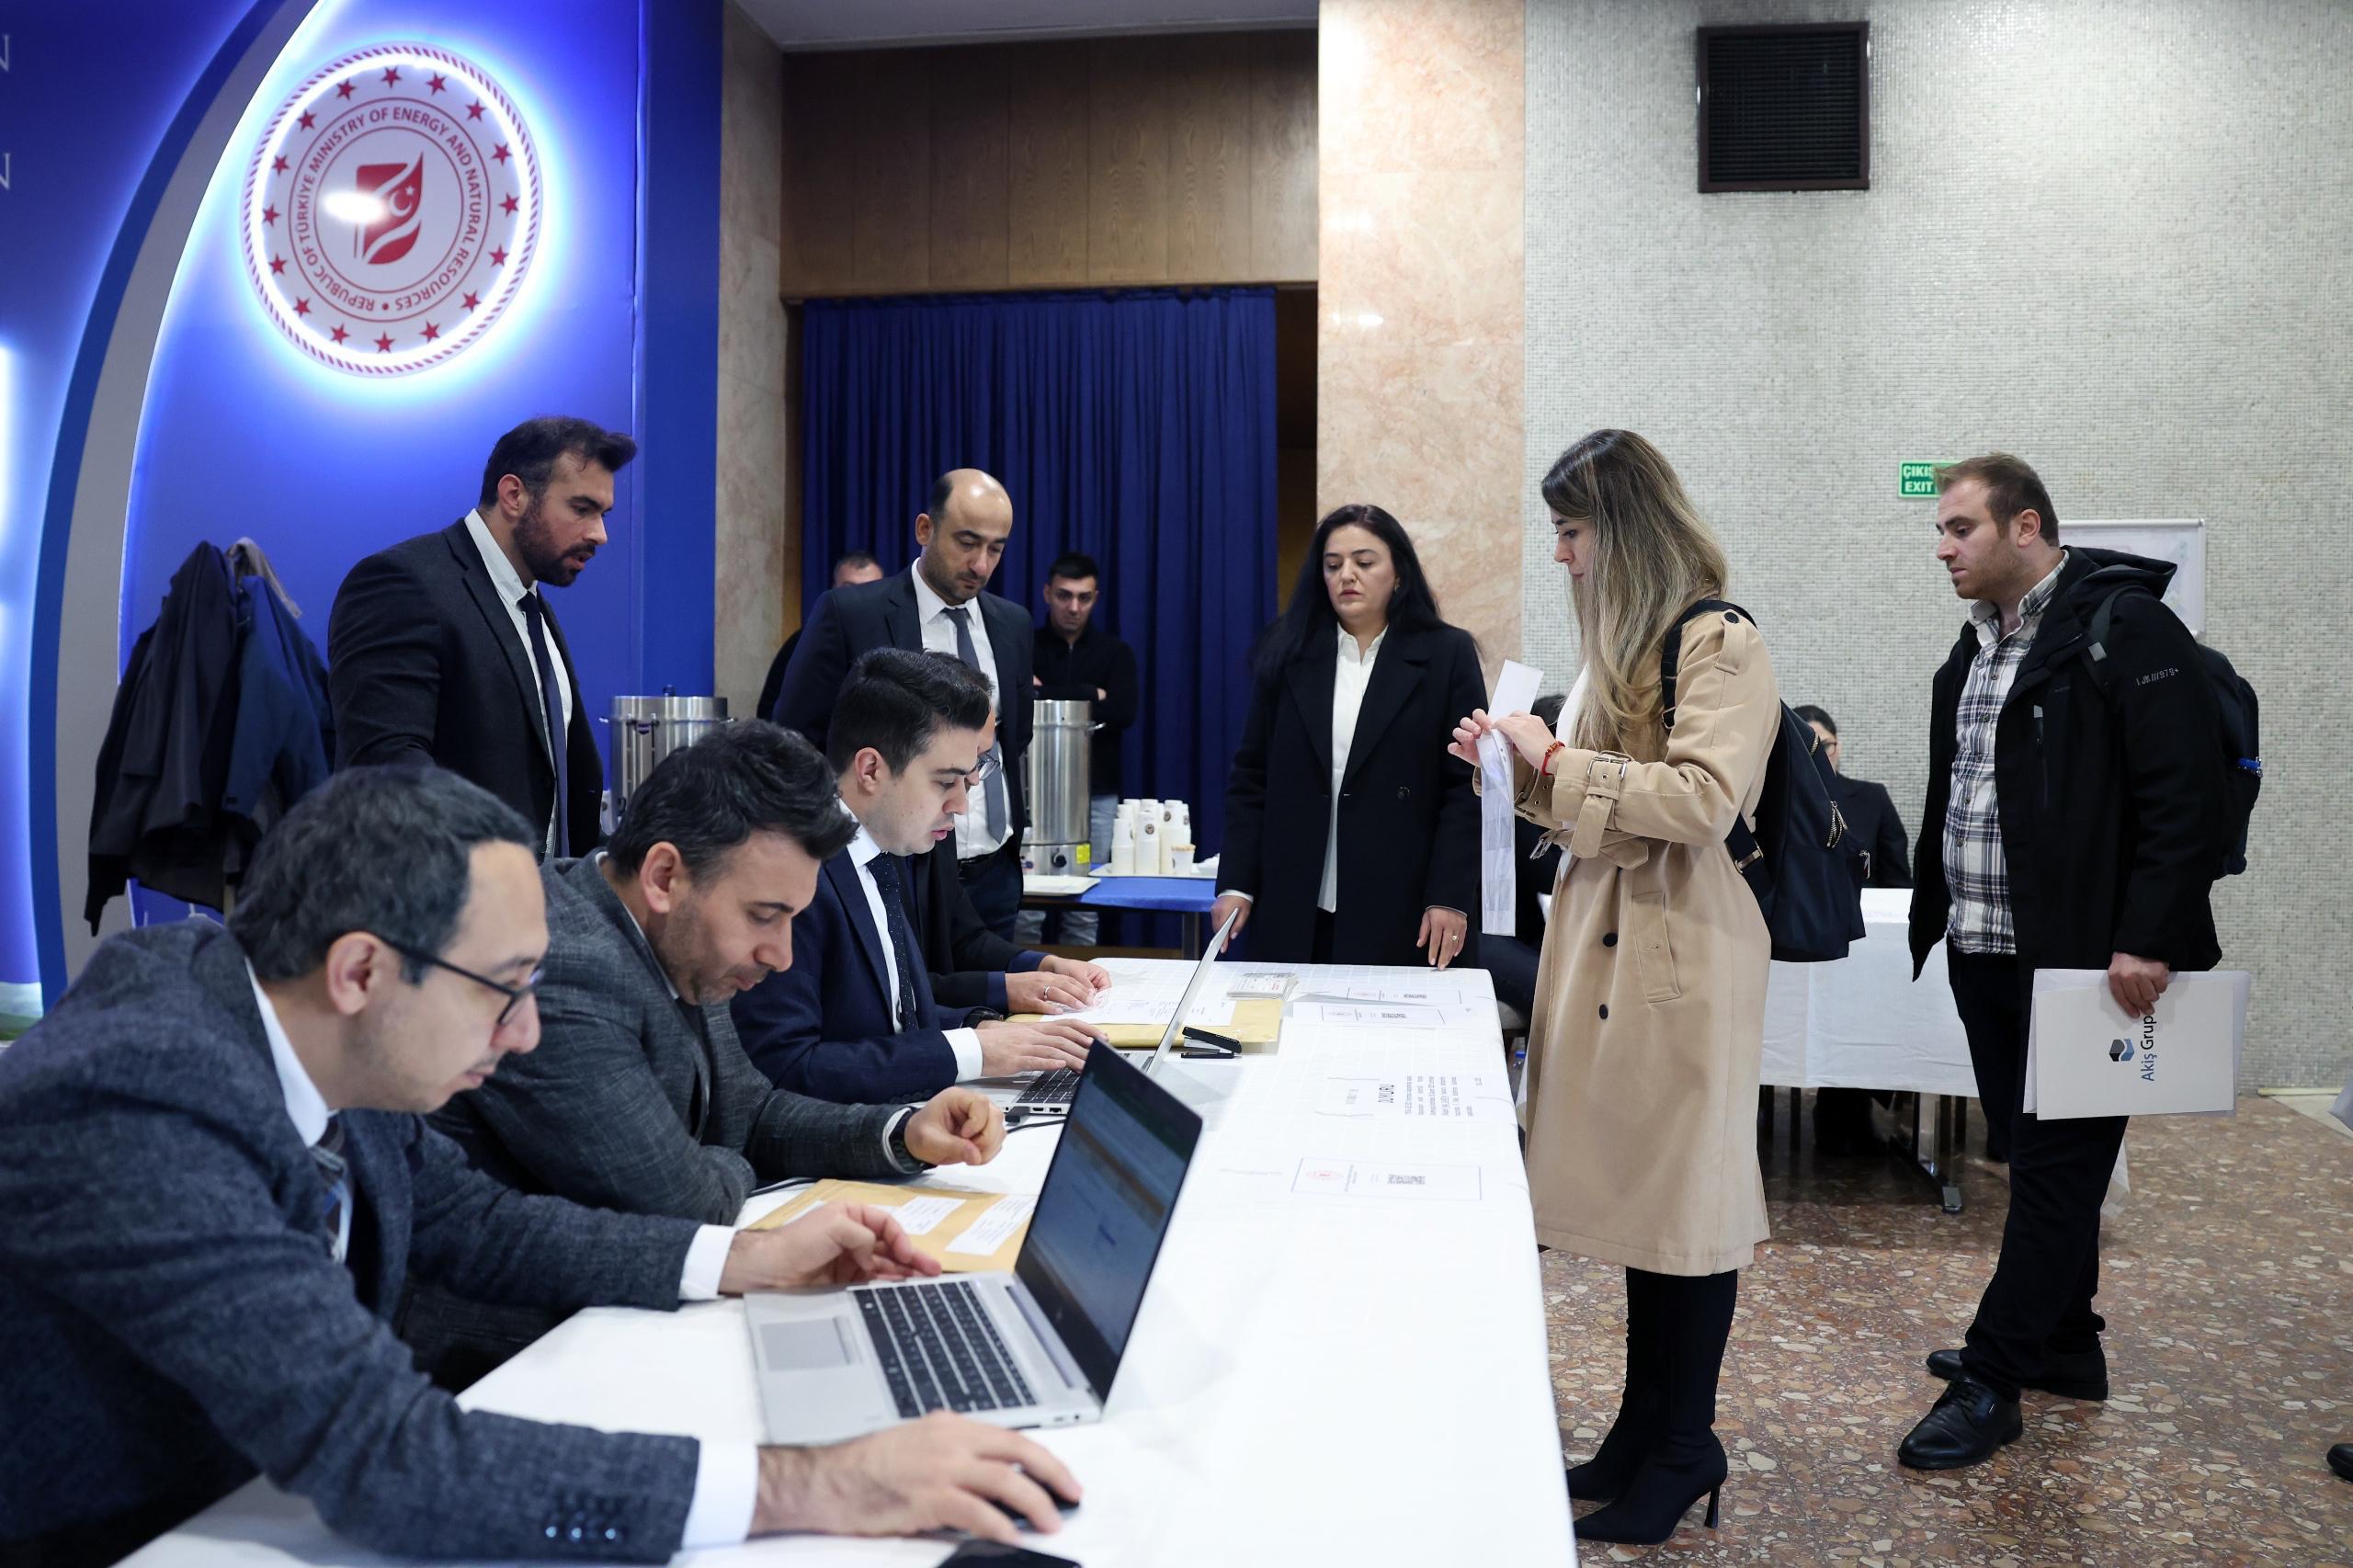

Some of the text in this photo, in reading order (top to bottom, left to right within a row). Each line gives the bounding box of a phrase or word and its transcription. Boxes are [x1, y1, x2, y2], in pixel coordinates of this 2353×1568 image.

[296, 107, 482, 312] REPUBLIC OF TÜRKİYE MINISTRY OF ENERGY AND NATURAL RESOURCES
[1904, 482, 1934, 493] EXIT
[2141, 1015, 2157, 1081] Akiş Grup
